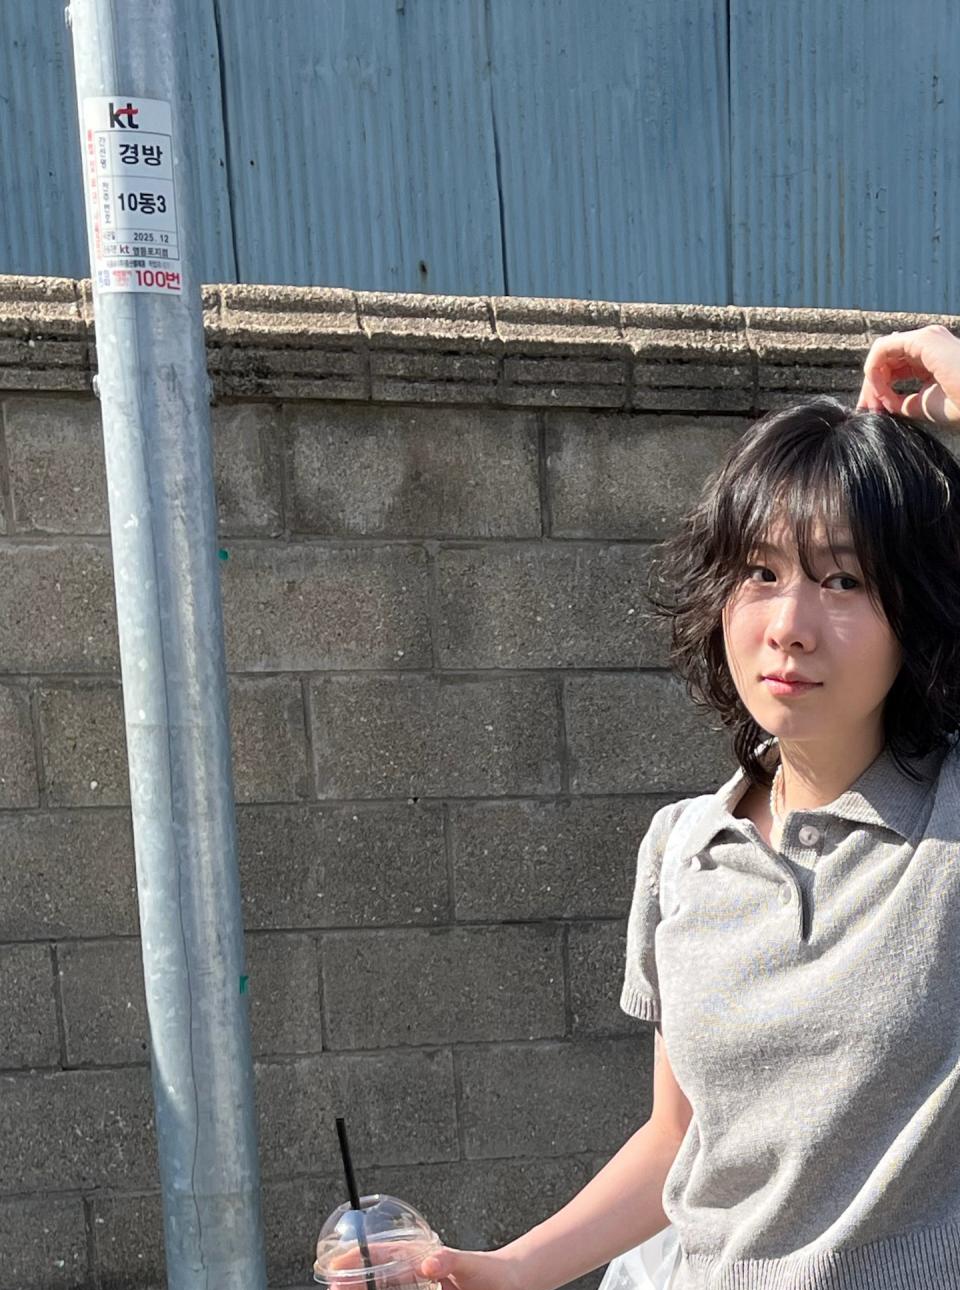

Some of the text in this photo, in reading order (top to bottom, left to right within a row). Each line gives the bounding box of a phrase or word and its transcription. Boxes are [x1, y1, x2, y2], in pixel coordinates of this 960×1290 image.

[109, 102, 139, 129] kt
[119, 143, 163, 166] 경방
[117, 192, 167, 214] 10동3
[135, 269, 181, 290] 100번
